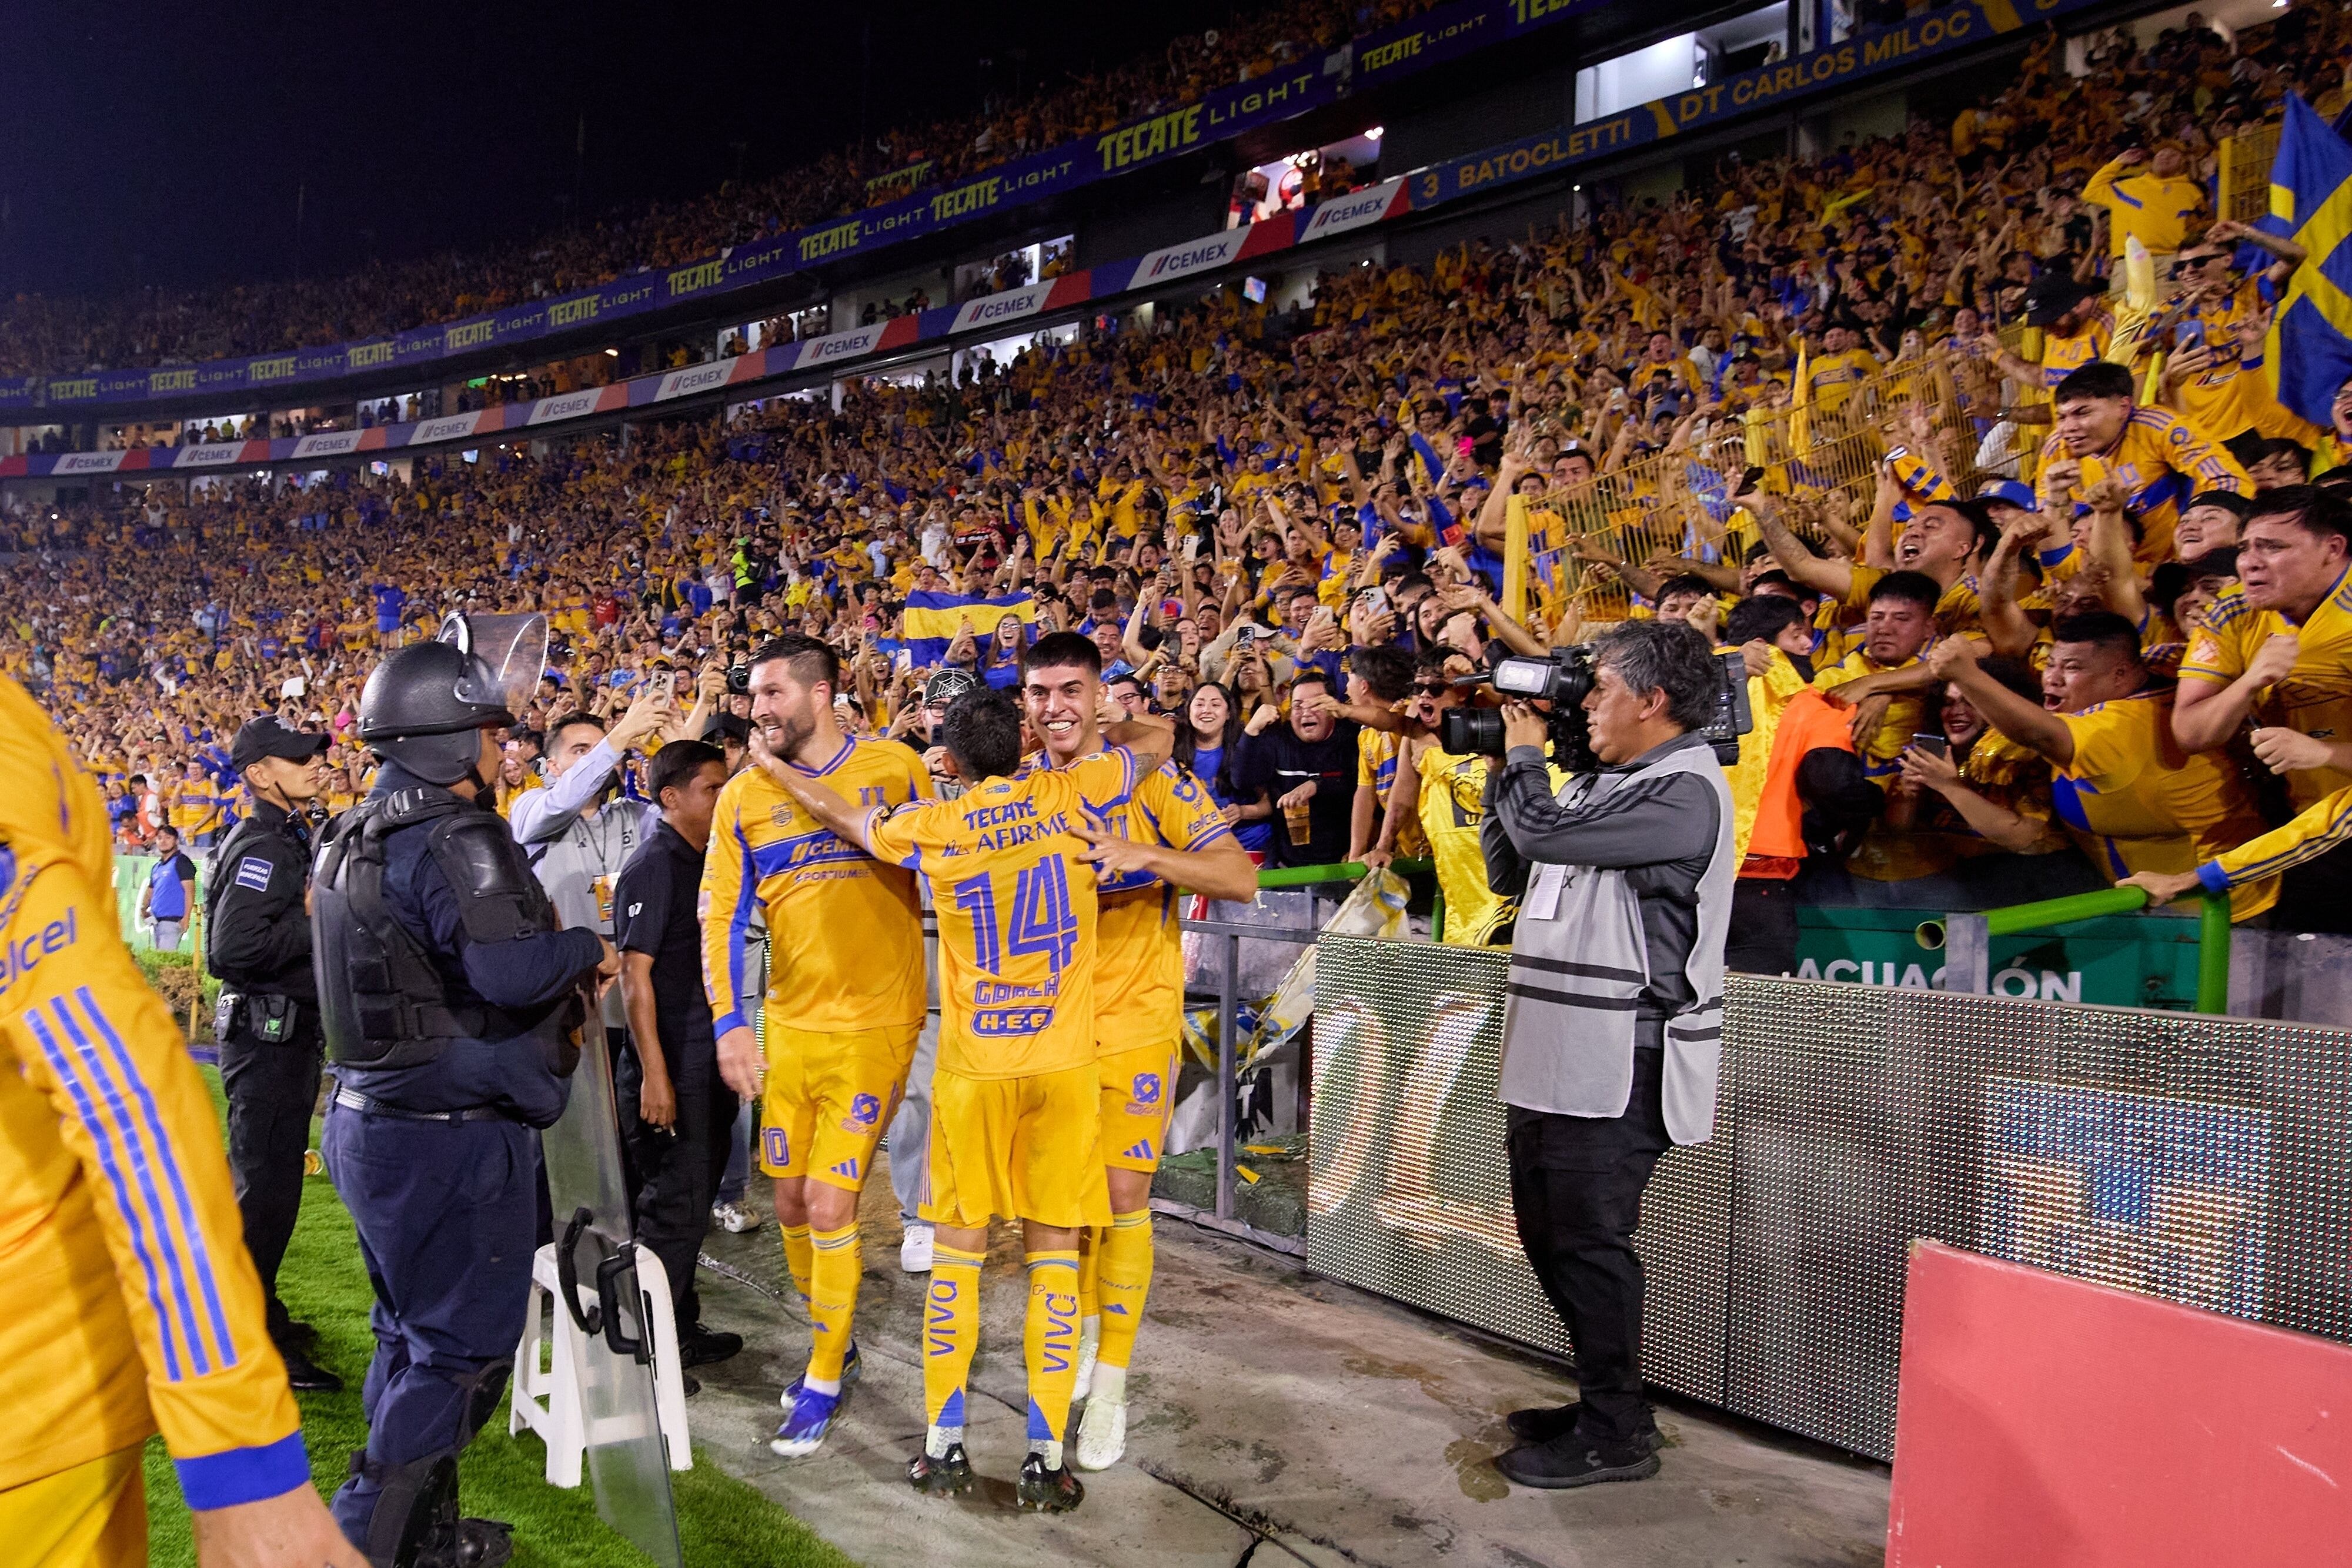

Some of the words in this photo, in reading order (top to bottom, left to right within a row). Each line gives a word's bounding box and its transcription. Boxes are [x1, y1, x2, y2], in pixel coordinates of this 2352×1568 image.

[1361, 31, 1426, 74] TECATE
[1426, 13, 1487, 44] LIGHT
[1679, 86, 1725, 123] DT
[1731, 46, 1856, 106] CARLOS
[1863, 8, 1972, 66] MILOC
[1095, 101, 1205, 172] TECATE
[1209, 73, 1314, 126] LIGHT
[1422, 176, 1439, 199] 3
[1458, 117, 1632, 189] BATOCLETTI
[930, 175, 1002, 223] TECATE
[1004, 161, 1073, 194] LIGHT
[1330, 197, 1384, 225] CEMEX
[799, 219, 861, 260] TECATE
[864, 207, 925, 235] LIGHT
[667, 258, 726, 296] TECATE
[728, 248, 783, 273] LIGHT
[1168, 242, 1228, 272] CEMEX
[548, 294, 600, 327] TECATE
[602, 287, 652, 309] LIGHT
[984, 295, 1035, 319] CEMEX
[446, 319, 495, 350] TECATE
[497, 312, 544, 332] LIGHT
[824, 335, 870, 355] CEMEX
[348, 341, 395, 367] TECATE
[397, 336, 443, 353] LIGHT
[149, 370, 198, 392] TECATE
[199, 368, 243, 383] LIGHT
[249, 356, 296, 381] TECATE
[298, 355, 344, 369] LIGHT
[681, 369, 723, 389] CEMEX
[49, 379, 99, 400] TECATE
[101, 379, 145, 392] LIGHT
[552, 399, 591, 416] CEMEX
[433, 421, 467, 438] CEMEX
[196, 450, 232, 463] CEMEX
[315, 437, 350, 453] CEMEX
[77, 458, 113, 468] CEMEX
[963, 795, 1038, 831] TECATE
[1187, 810, 1220, 835] telce
[977, 810, 1071, 852] AFIRME
[954, 853, 1078, 977] 14
